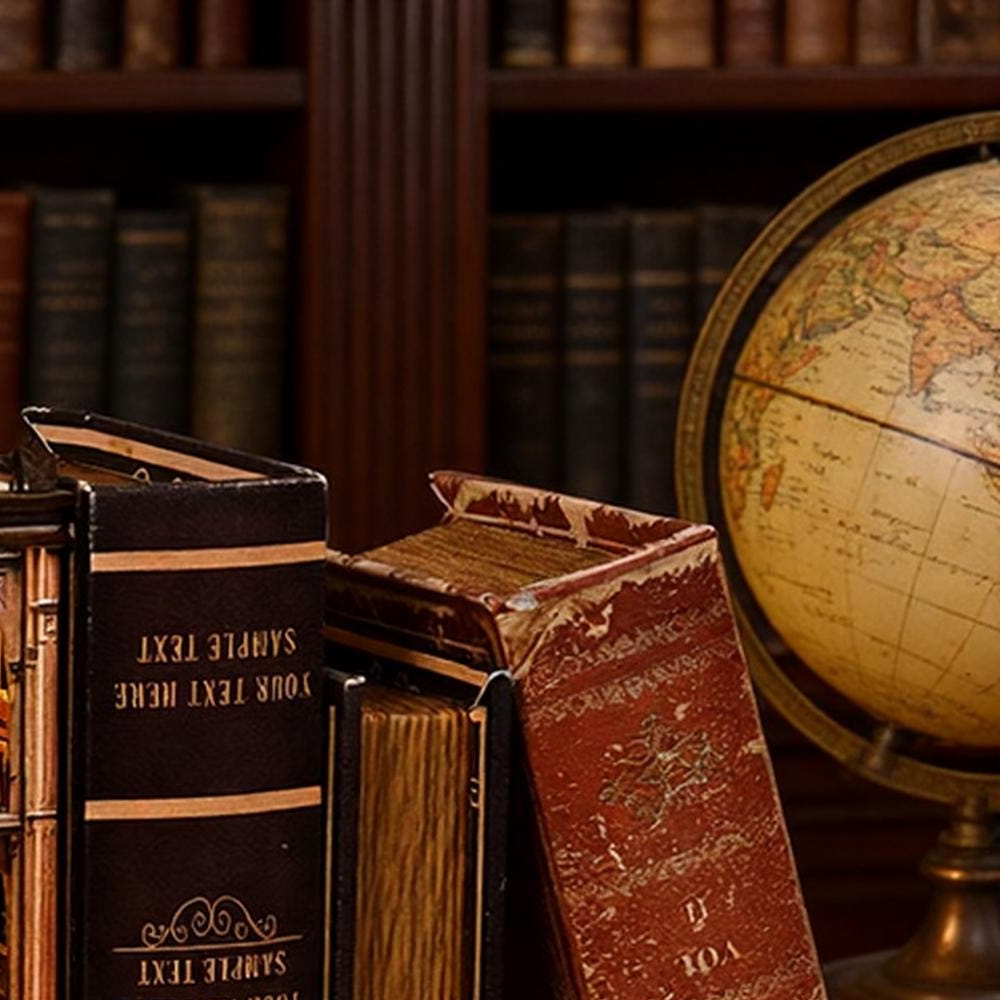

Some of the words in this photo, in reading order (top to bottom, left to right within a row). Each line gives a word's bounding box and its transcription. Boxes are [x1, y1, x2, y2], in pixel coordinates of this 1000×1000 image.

[138, 635, 198, 663] TEXT
[209, 628, 296, 661] SAMPLE
[115, 681, 176, 709] HERE
[188, 678, 245, 706] TEXT
[256, 673, 311, 702] YOUR
[139, 960, 194, 985] TEXT
[200, 950, 285, 982] SAMPLE
